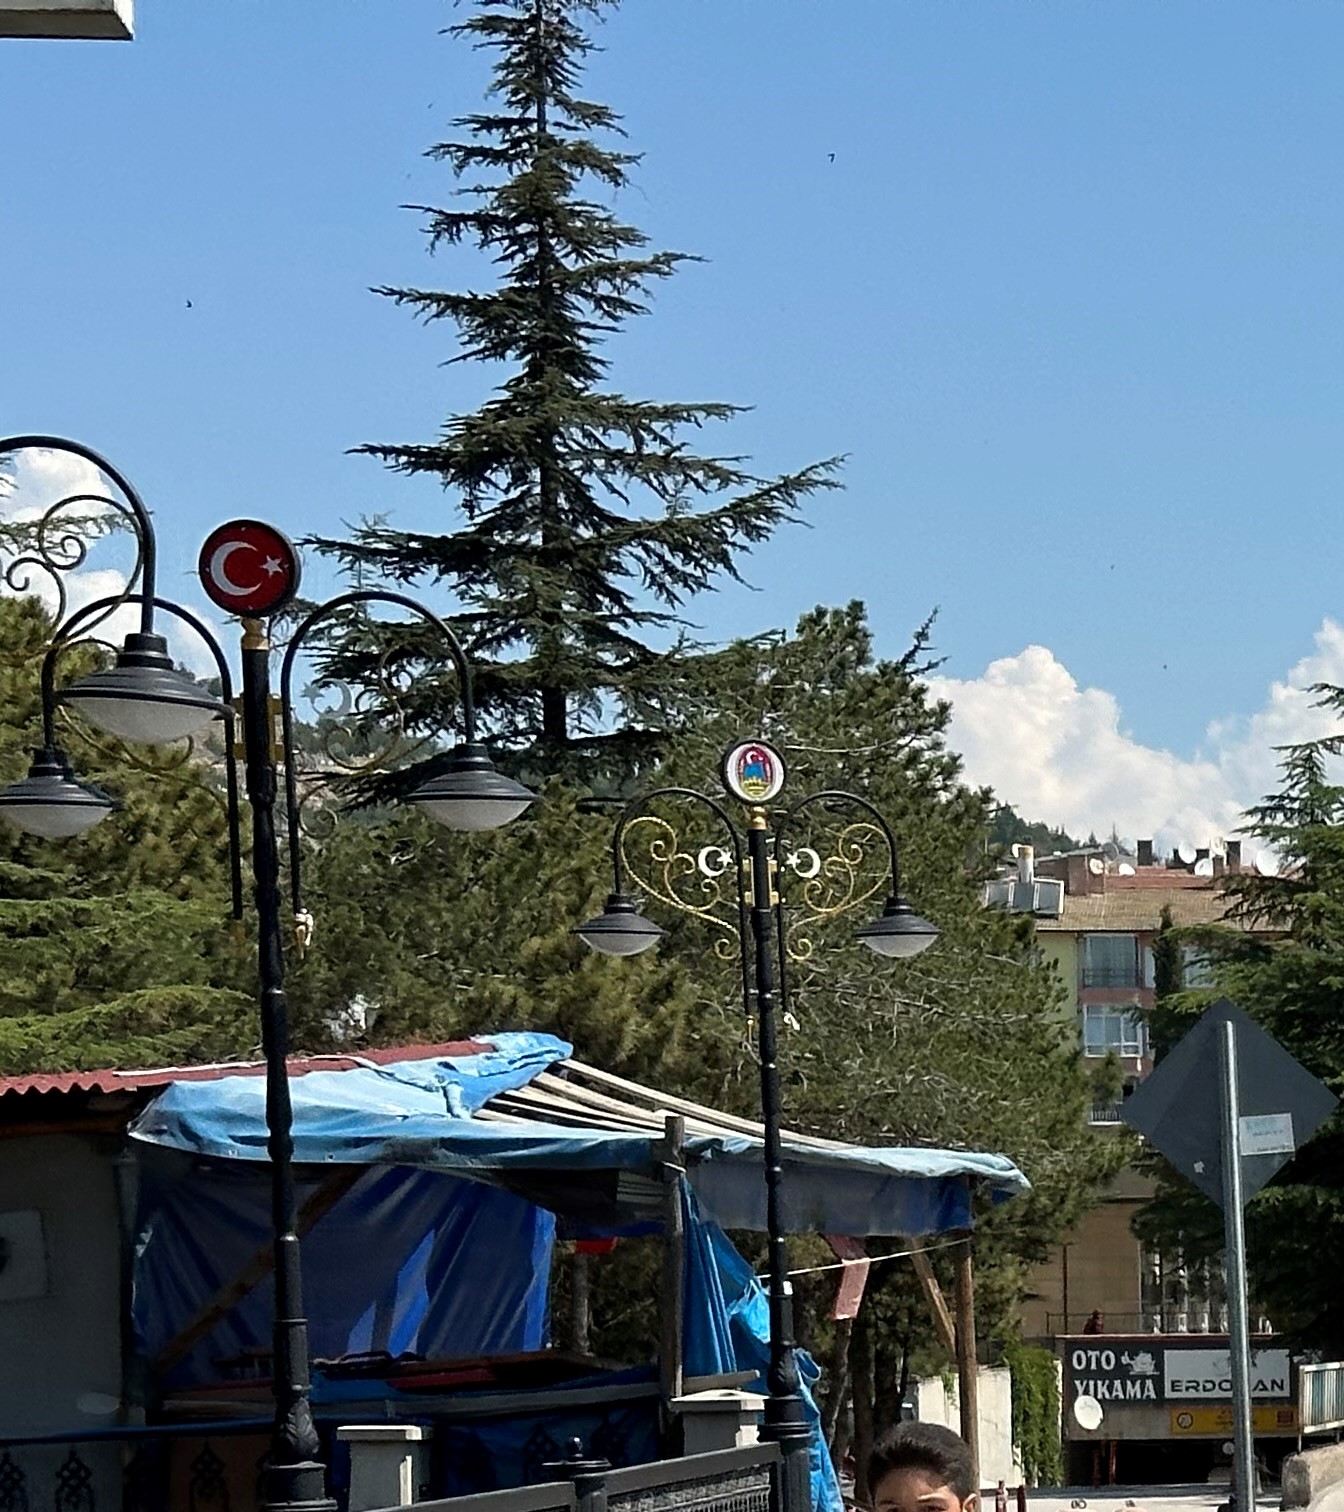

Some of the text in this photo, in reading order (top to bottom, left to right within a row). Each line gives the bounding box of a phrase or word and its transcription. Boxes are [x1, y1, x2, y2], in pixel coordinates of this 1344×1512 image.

[1072, 1350, 1116, 1370] OTO
[1074, 1379, 1157, 1400] YIKAMA
[1170, 1379, 1285, 1393] ERDOAN
